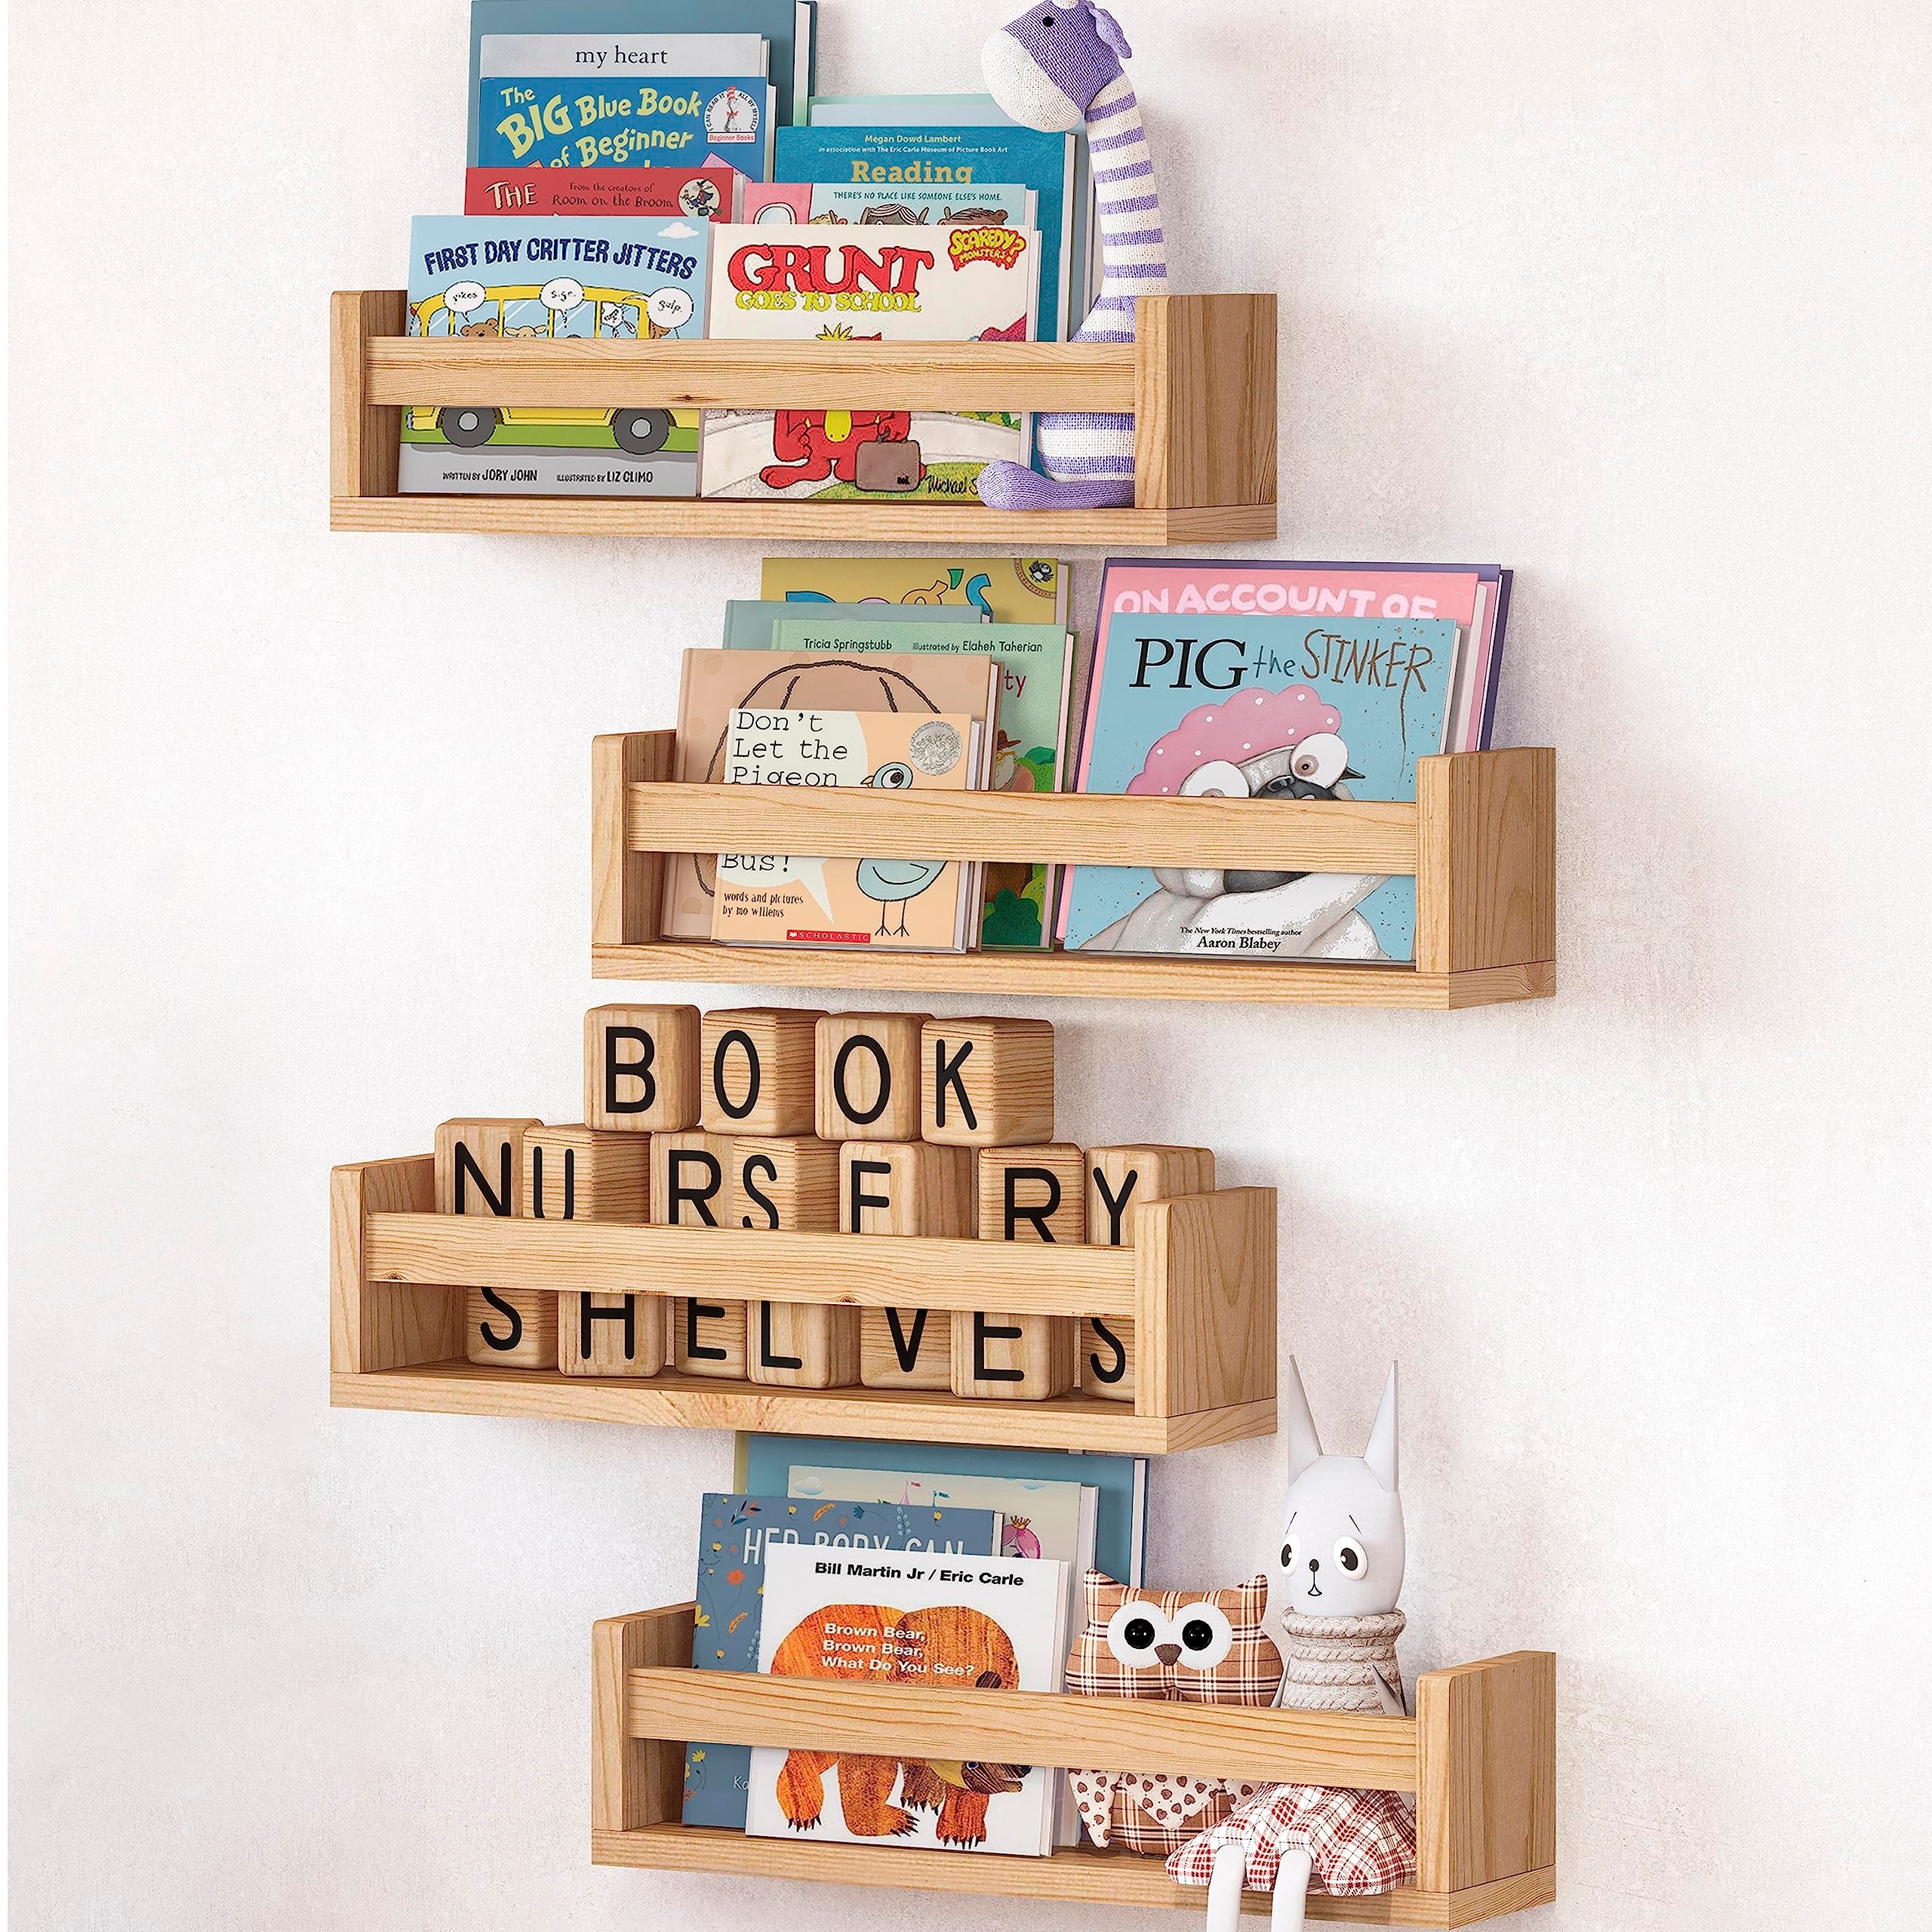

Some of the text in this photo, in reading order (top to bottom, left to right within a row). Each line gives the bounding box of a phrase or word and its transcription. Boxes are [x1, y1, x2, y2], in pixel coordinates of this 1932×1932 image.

[575, 45, 668, 67] my heart
[500, 87, 535, 106] The
[707, 97, 718, 112] READ
[496, 88, 703, 159] BIG Blue Book
[550, 128, 694, 168] of Beginner
[865, 135, 894, 145] Megan
[486, 181, 538, 210] THE
[570, 182, 589, 191] From
[593, 182, 605, 191] the
[644, 183, 654, 192] of
[877, 192, 898, 200] PLACE
[955, 192, 977, 201] ELSE'S
[552, 193, 674, 208] Room on the Broom
[424, 237, 697, 280] FIRST DAY CRITTER JITTERS
[728, 244, 934, 295] GRUNT
[736, 291, 921, 313] GOES TO SCHOOL
[482, 469, 509, 481] JORY
[510, 469, 537, 481] JOHN
[607, 471, 621, 482] LIZ
[623, 471, 653, 483] CLIMO
[1113, 583, 1438, 619] ON ACCOUNT OF
[804, 638, 892, 653] Tricia Springstubb
[951, 643, 960, 653] by
[963, 641, 995, 651] Elaheh
[998, 641, 1042, 652] Taherian
[1129, 629, 1434, 693] PIG the STINKER
[737, 712, 823, 732] Don't
[733, 738, 848, 760] Let the
[731, 764, 839, 787] Pigeon
[721, 854, 789, 872] Bus!
[724, 892, 804, 905] words and pictures
[723, 905, 784, 918] by mo willems
[798, 931, 869, 942] SCHOLASTIC
[1247, 928, 1280, 937] bestselling
[1196, 935, 1281, 952] Aaron Blabey
[605, 1026, 978, 1131] BOOK
[815, 1562, 841, 1574] Bill
[847, 1563, 901, 1578] Martin
[906, 1567, 925, 1580] Jr
[940, 1570, 974, 1583] Eric
[979, 1572, 1024, 1586] Carle
[824, 1623, 926, 1642] Brown Bear,
[823, 1639, 924, 1658] Brown Bear,
[821, 1656, 975, 1676] What Do You See?
